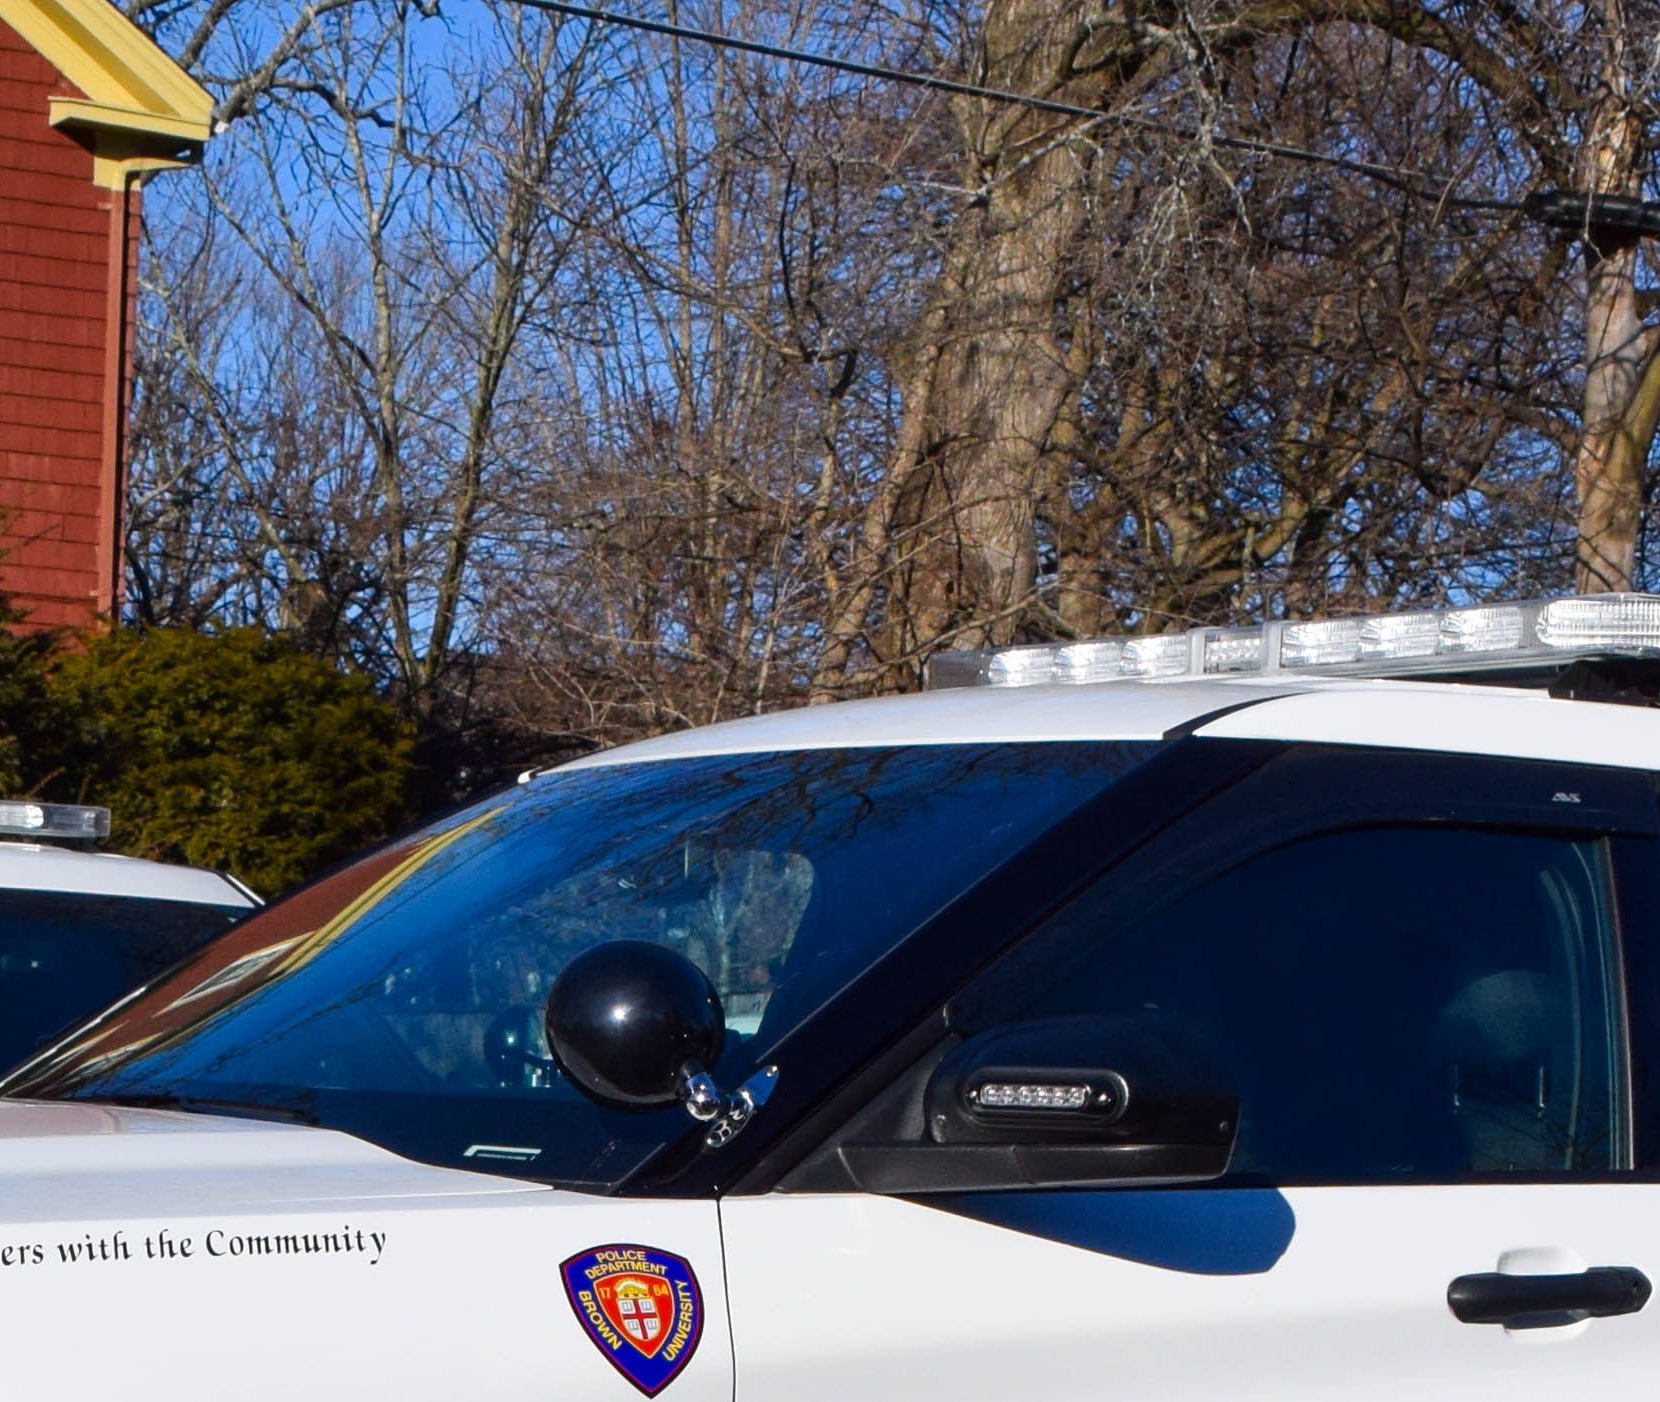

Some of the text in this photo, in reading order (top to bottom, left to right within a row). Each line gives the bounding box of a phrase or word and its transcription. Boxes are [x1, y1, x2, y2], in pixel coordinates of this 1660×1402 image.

[57, 1231, 132, 1262] with
[144, 1229, 193, 1259] the
[205, 1226, 387, 1265] Community
[595, 1250, 647, 1264] POLICE
[584, 1260, 668, 1280] DEPARTMENT
[599, 1284, 669, 1300] 17 64
[578, 1290, 623, 1351] BROWN
[661, 1279, 694, 1362] UNIVERSITY
